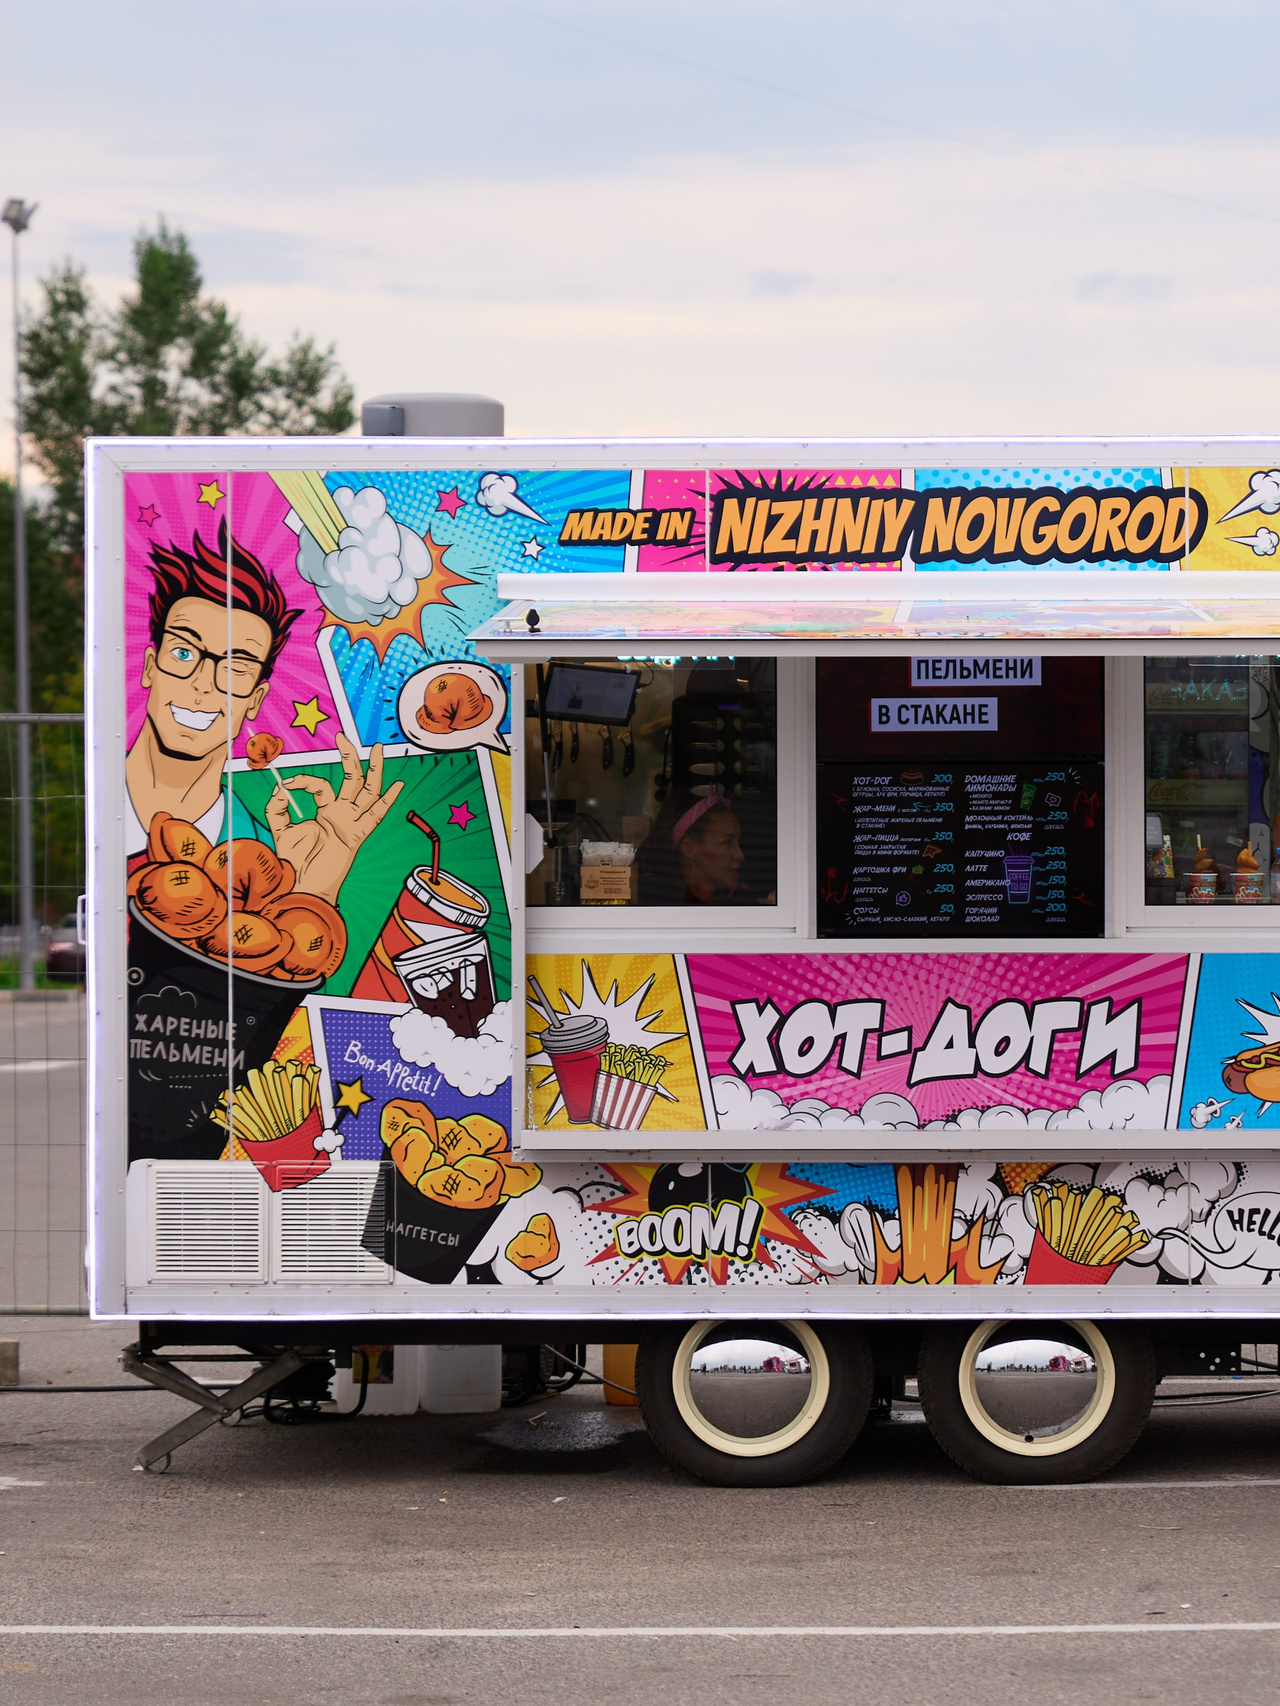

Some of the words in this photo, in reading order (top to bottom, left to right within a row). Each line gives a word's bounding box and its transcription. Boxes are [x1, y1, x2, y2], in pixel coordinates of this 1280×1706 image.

[559, 511, 653, 541] MADE
[655, 511, 692, 541] IN
[715, 496, 916, 555] NIZHNIY
[919, 495, 1199, 556] NOVGOROD
[916, 658, 1033, 680] ПЕЛЬМЕНИ
[878, 704, 891, 725] В
[897, 704, 989, 725] СТАКАНЕ
[964, 774, 1017, 783] ДОМАШНИЕ
[964, 783, 1017, 792] ЛИМОНАДЫ
[1006, 832, 1032, 841] КОФЕ
[964, 850, 1005, 858] КАПУЧИНО
[964, 864, 989, 872] ЛАТТЕ
[964, 879, 1011, 887] АМЕРИКАНО
[965, 893, 1004, 901] ЭСПРЕССО
[964, 906, 998, 914] ГОРЯЧИЙ
[964, 915, 1000, 923] ШОКОЛАД
[135, 1013, 238, 1041] ЖАРЕНЫЕ
[731, 997, 1141, 1086] ХОТ-ДОГИ
[129, 1038, 246, 1070] ПЕЛЬМЕНИ
[343, 1039, 375, 1071] Bon
[386, 1219, 460, 1247] НАГГЕТСЫ
[616, 1197, 763, 1259] BOOM!
